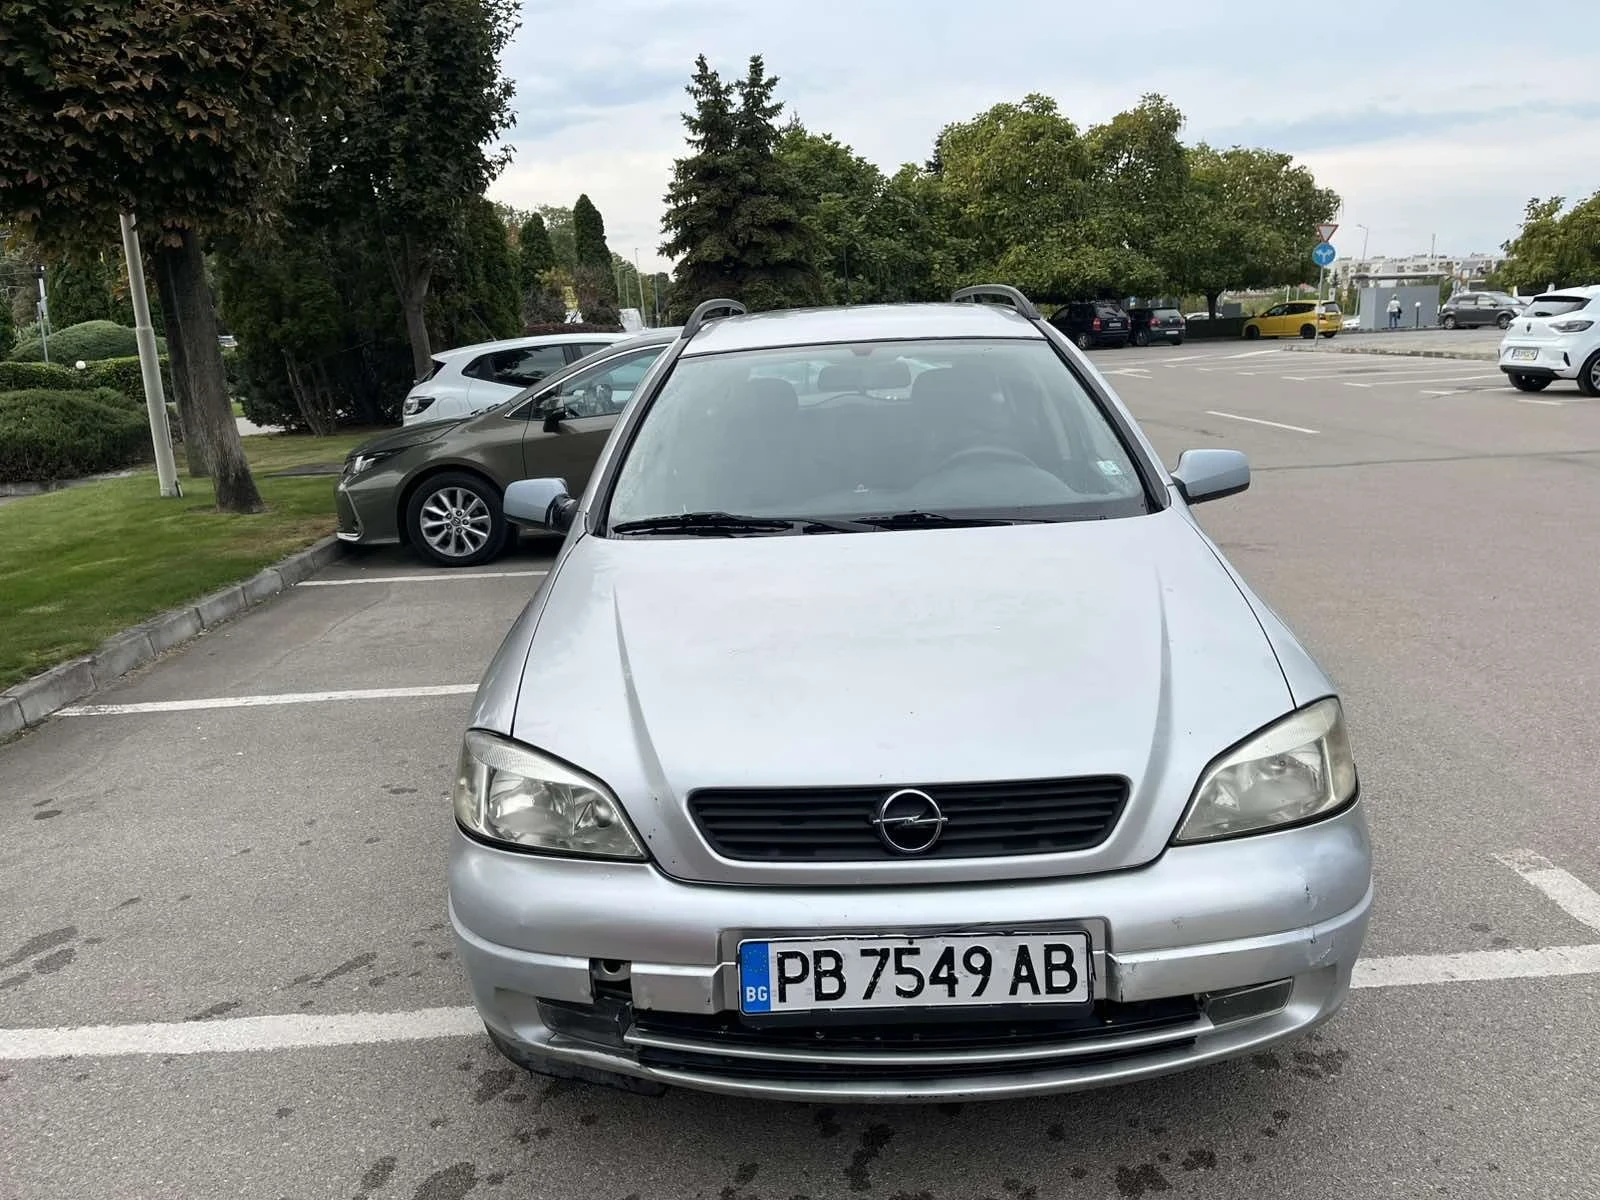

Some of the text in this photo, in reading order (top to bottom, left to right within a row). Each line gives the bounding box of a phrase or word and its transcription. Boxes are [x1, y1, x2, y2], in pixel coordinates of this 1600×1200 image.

[777, 943, 1078, 1003] PB 7549 AB
[746, 986, 768, 1002] BG
